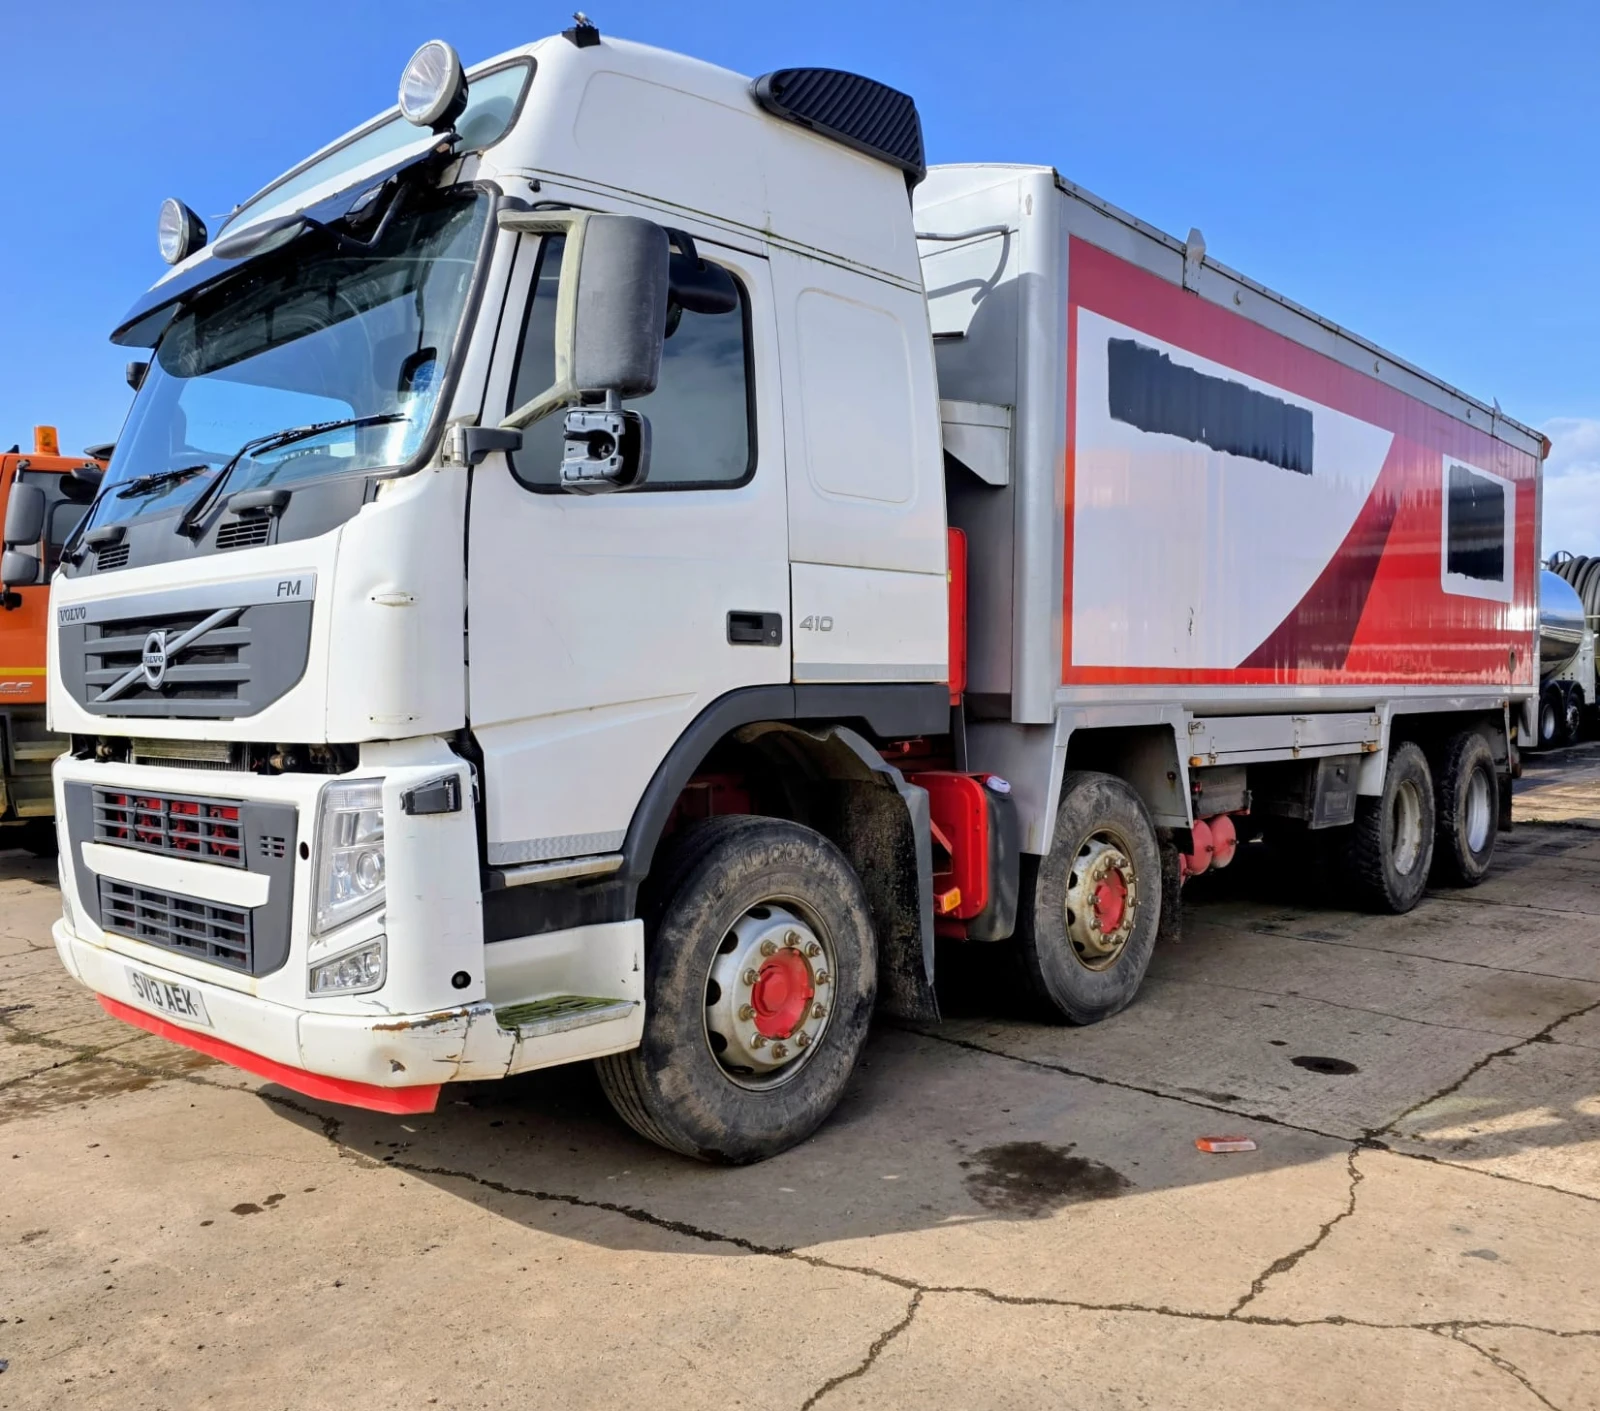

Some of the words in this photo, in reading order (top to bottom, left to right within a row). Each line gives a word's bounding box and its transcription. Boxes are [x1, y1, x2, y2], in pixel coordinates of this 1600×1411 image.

[277, 580, 301, 597] FM
[60, 606, 86, 621] VOLVO
[799, 615, 833, 631] 410
[132, 972, 163, 1007] SV13
[163, 984, 198, 1017] AEK
